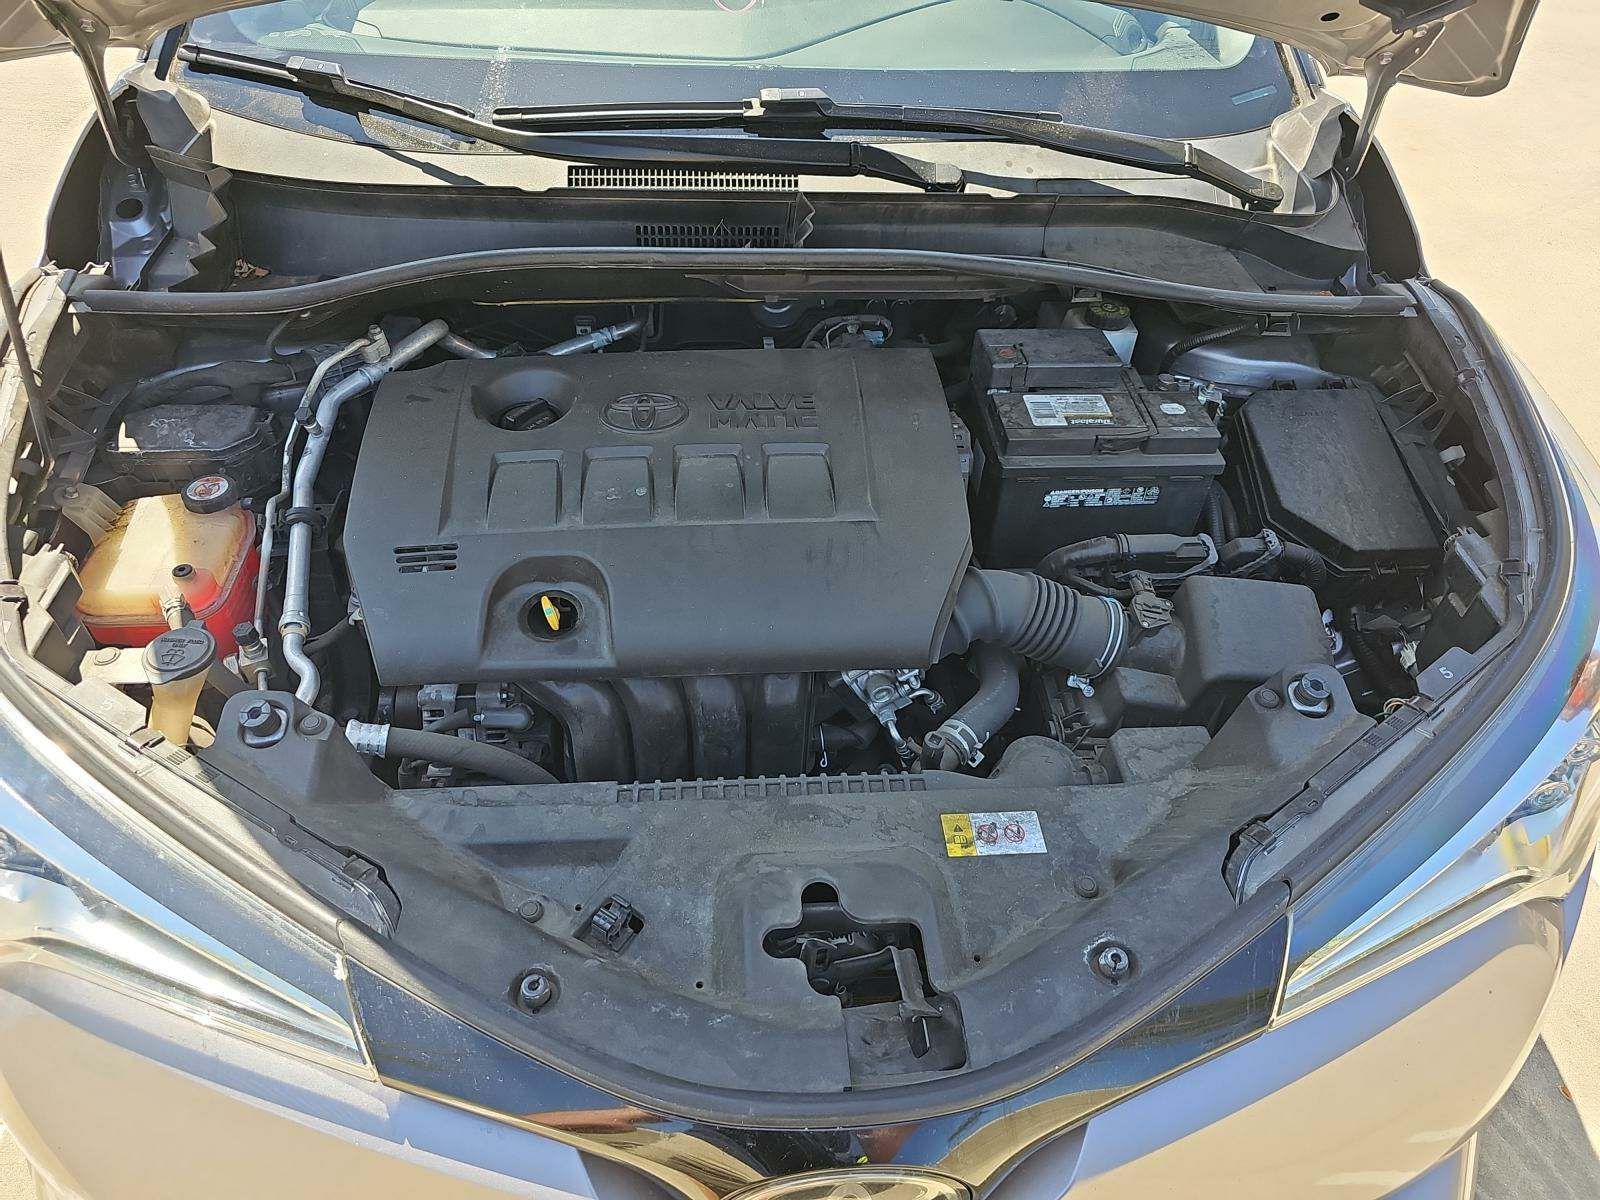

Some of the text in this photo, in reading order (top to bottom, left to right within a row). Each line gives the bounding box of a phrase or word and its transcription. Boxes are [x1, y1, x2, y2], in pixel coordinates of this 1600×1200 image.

[706, 392, 817, 411] VALVE
[708, 411, 819, 430] MATIC
[1438, 666, 1454, 679] 5
